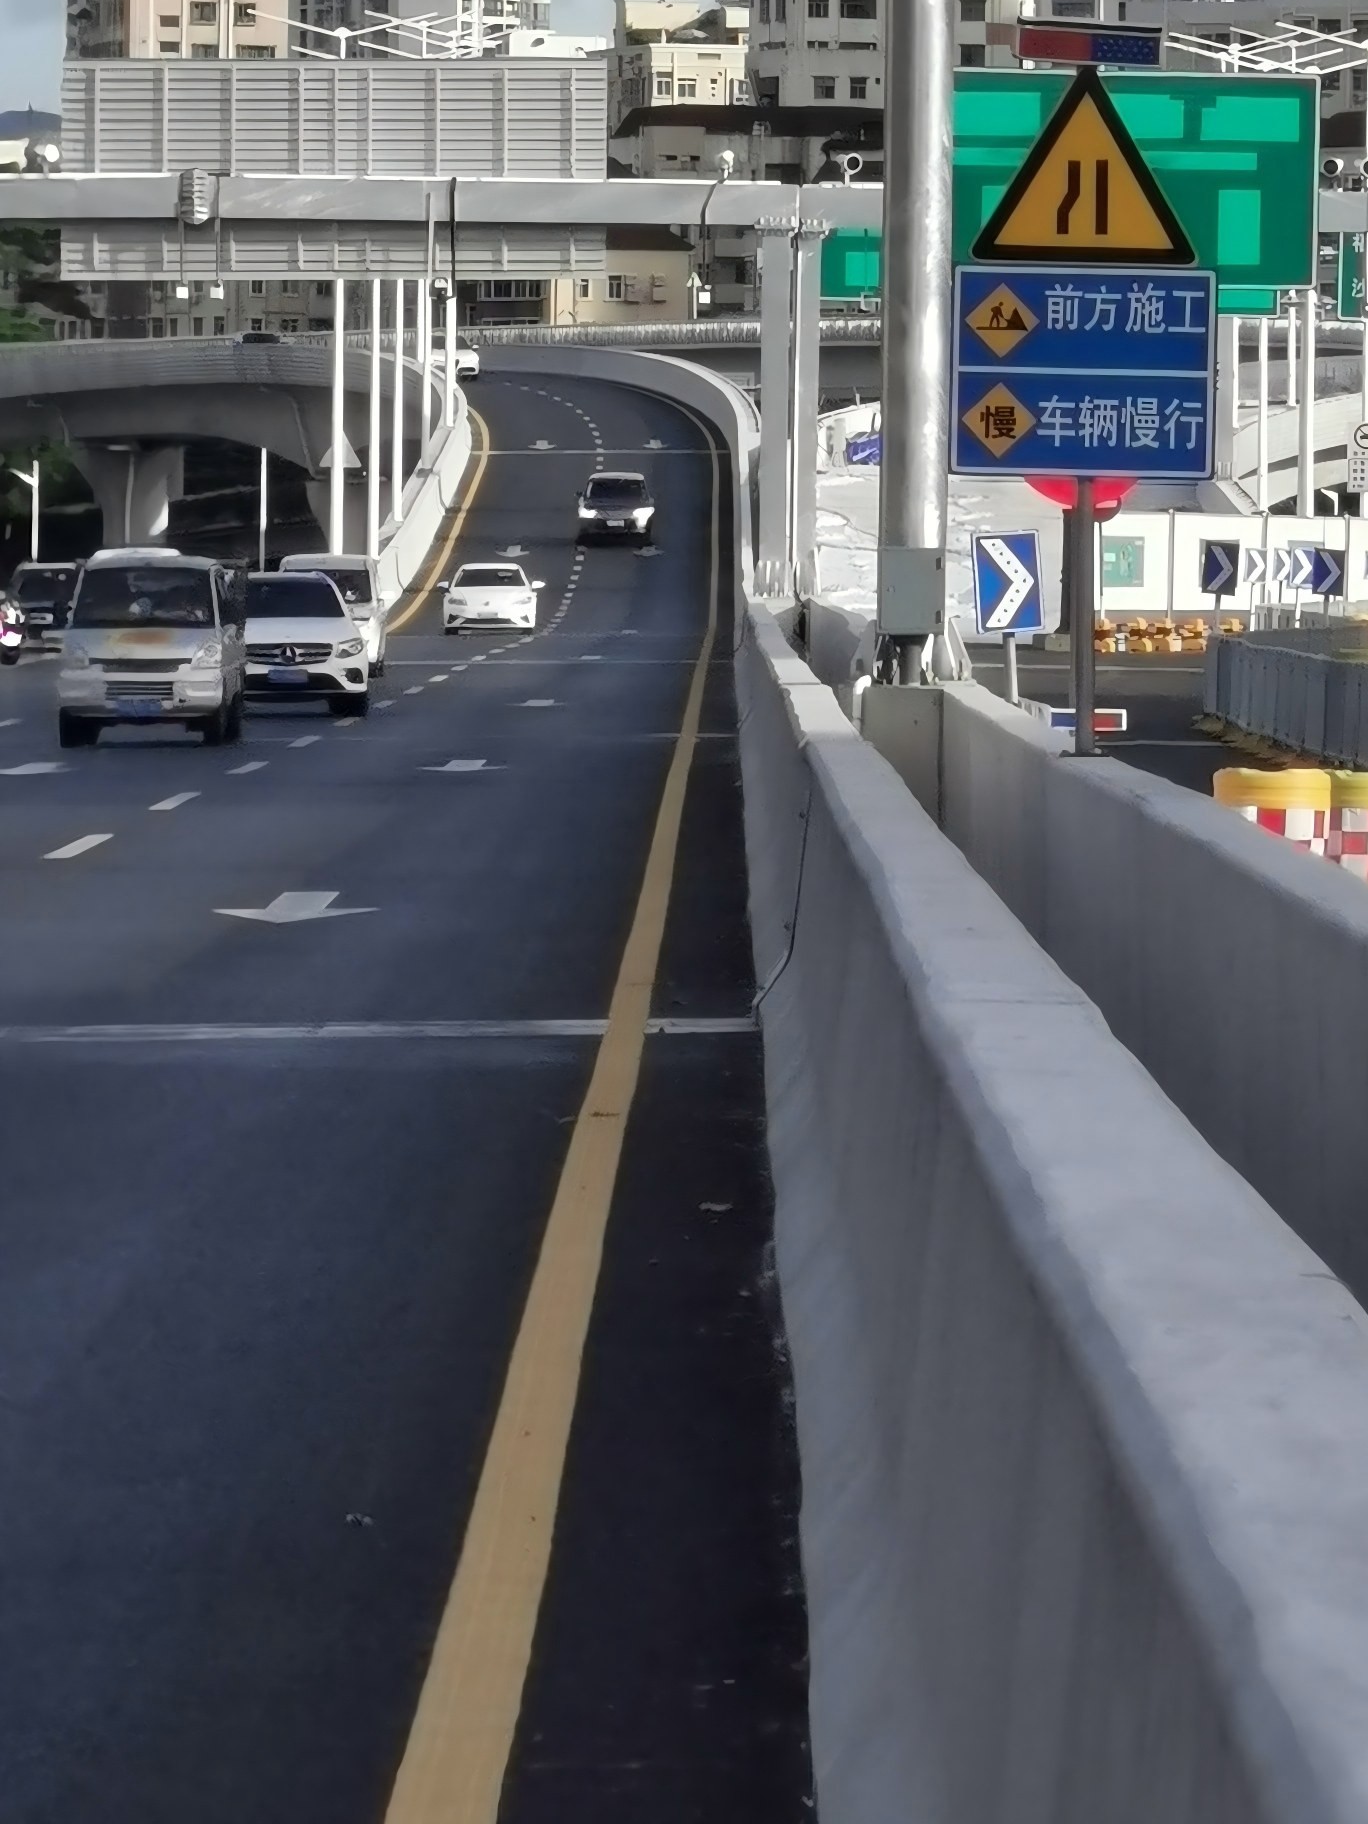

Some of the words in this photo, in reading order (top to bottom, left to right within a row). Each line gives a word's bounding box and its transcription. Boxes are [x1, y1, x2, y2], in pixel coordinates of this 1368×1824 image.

[1044, 282, 1206, 334] 前方施工
[979, 405, 1017, 440] 慢
[1036, 394, 1204, 450] 车辆慢行
